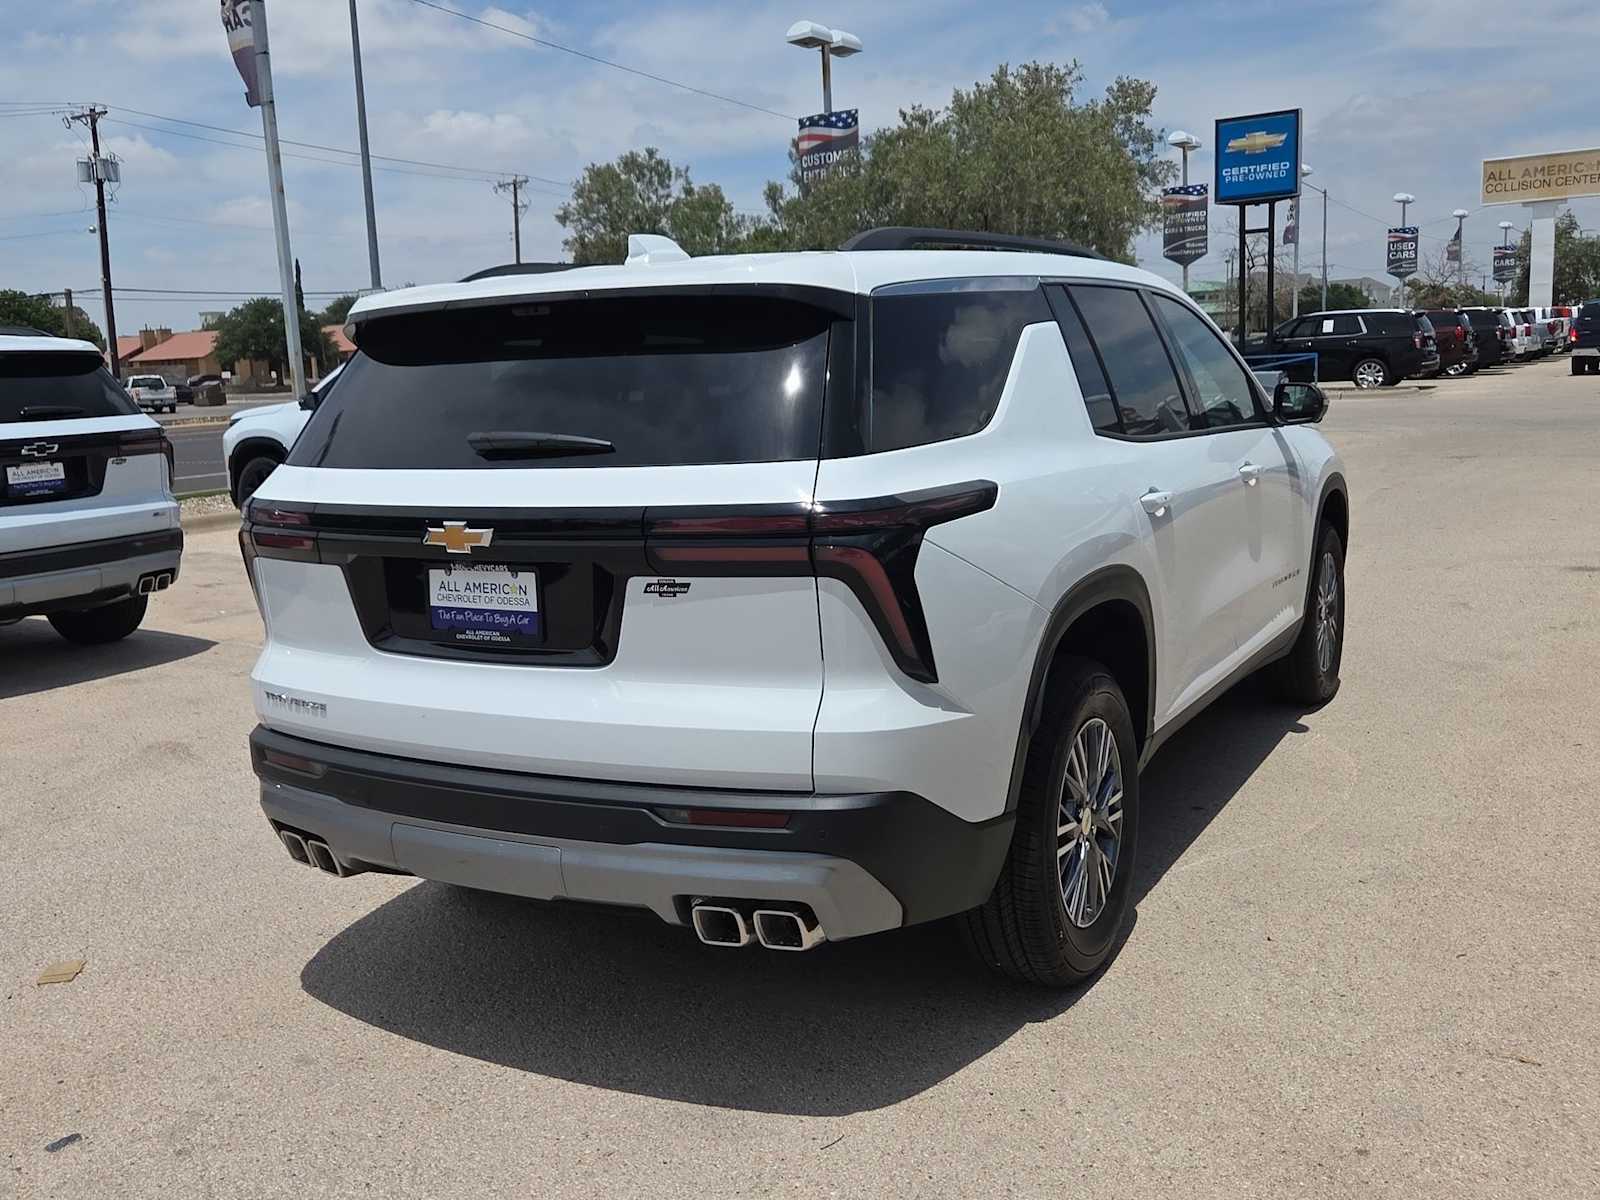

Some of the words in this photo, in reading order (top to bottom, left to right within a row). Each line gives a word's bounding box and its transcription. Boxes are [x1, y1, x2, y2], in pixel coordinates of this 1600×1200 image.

[1222, 161, 1290, 177] CERTIFIED
[1487, 169, 1516, 182] ALL
[1521, 160, 1600, 179] AMERIC
[1225, 169, 1287, 184] PRE-OWNED
[1485, 179, 1552, 194] COLLISION
[1389, 241, 1416, 251] USED
[1389, 250, 1416, 259] CARS
[1494, 258, 1515, 267] CARS
[438, 580, 461, 592] ALL
[437, 593, 483, 604] CHEVROLET
[484, 595, 495, 604] OF
[496, 596, 530, 606] ODESSA
[438, 609, 451, 620] The
[464, 611, 483, 622] Place
[484, 612, 494, 622] To
[494, 613, 509, 627] Buy
[509, 614, 516, 624] A
[516, 614, 530, 625] Car
